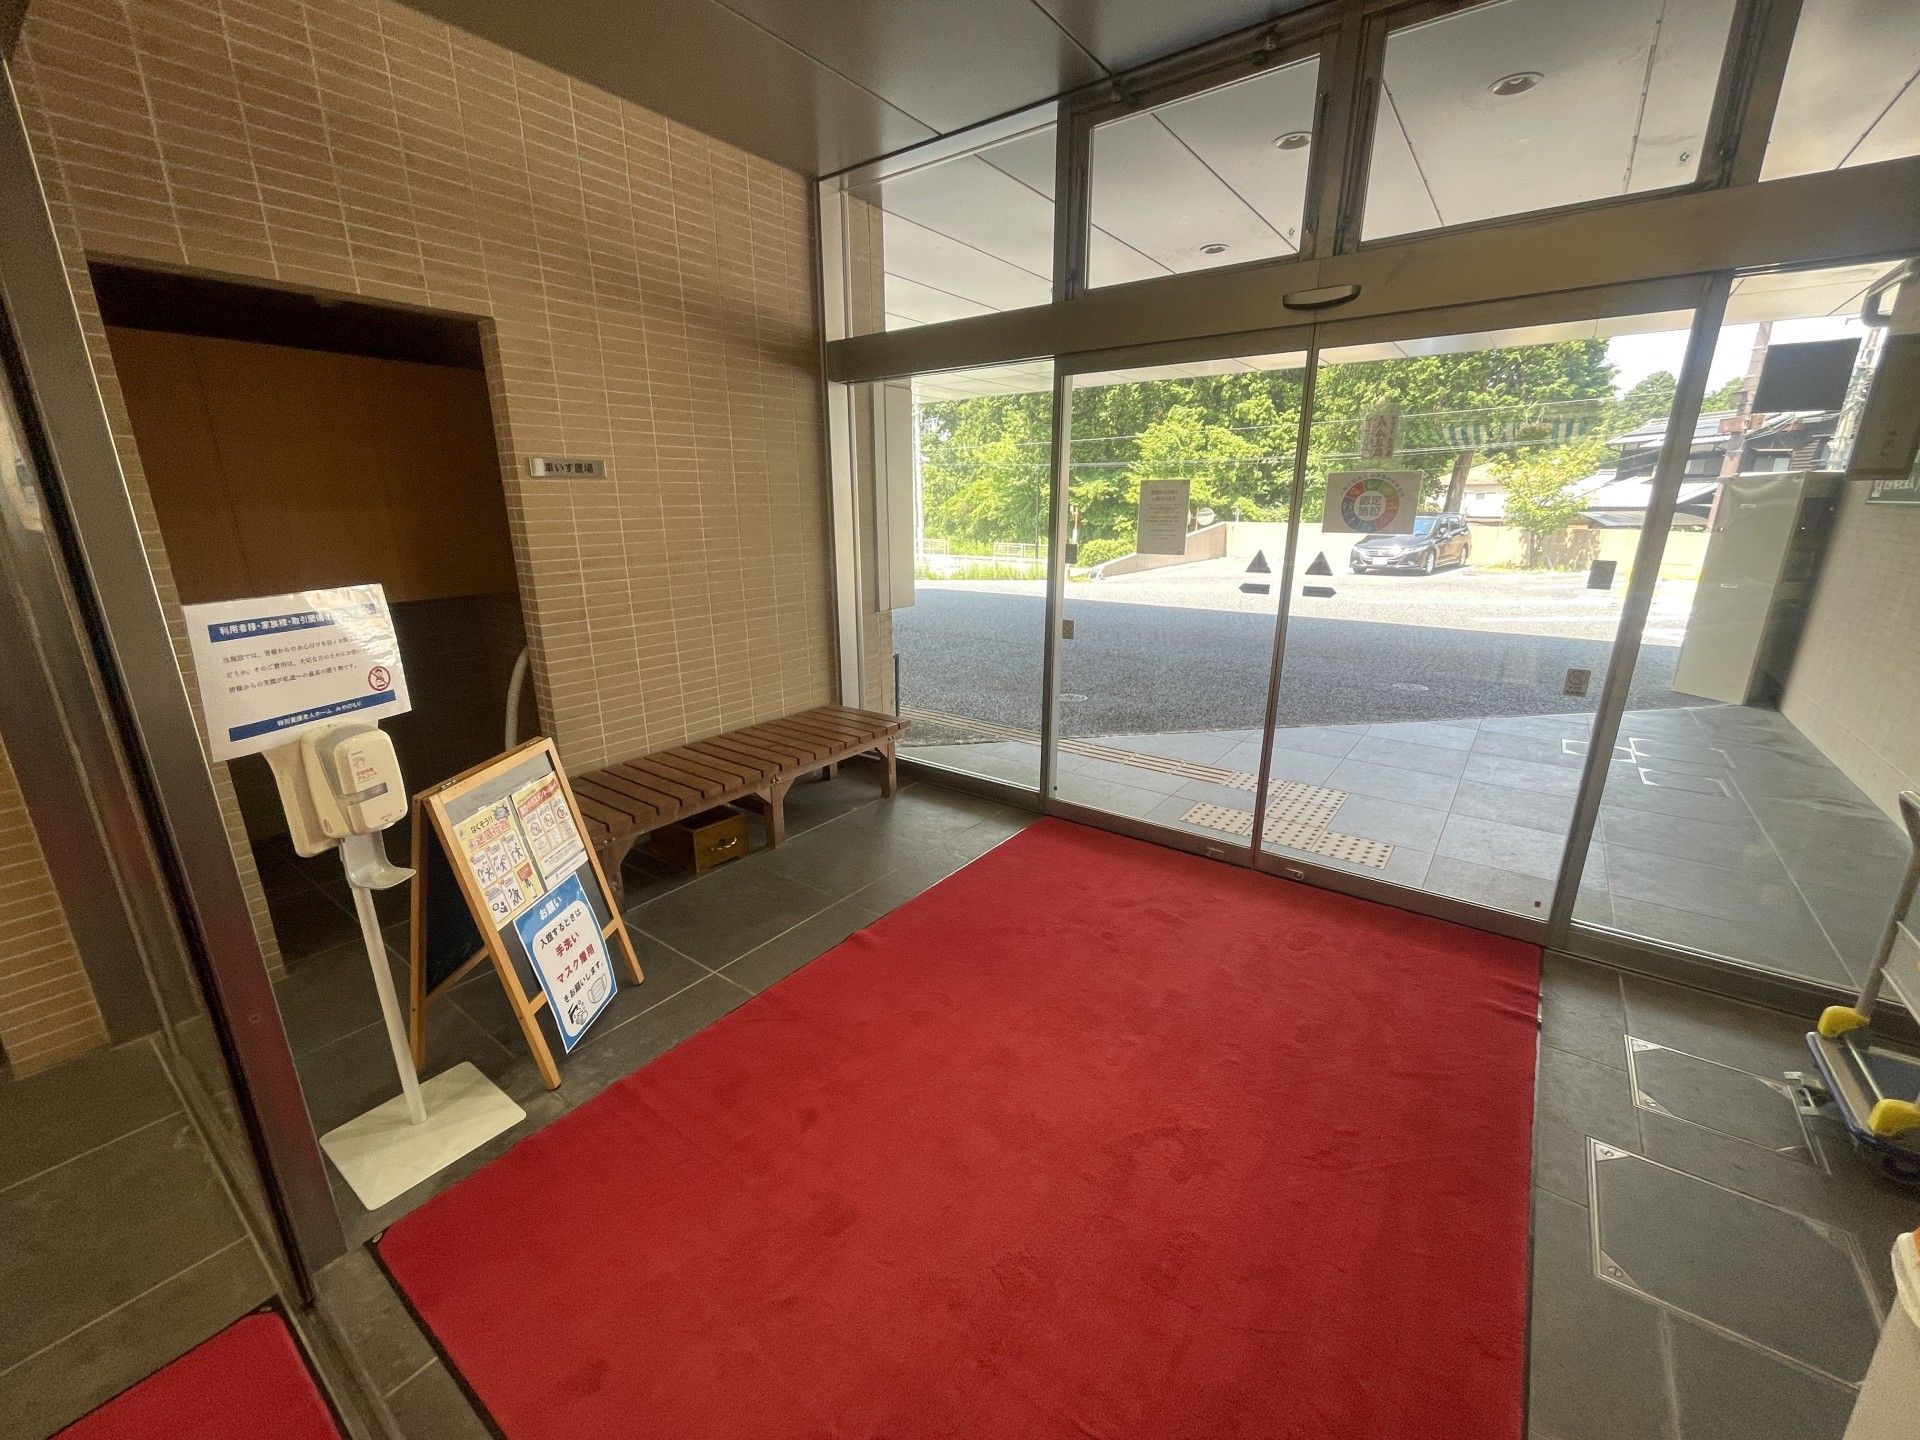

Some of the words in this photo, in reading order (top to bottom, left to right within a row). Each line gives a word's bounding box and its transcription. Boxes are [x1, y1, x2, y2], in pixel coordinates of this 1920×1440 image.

[538, 896, 562, 921] お願い
[554, 931, 580, 958] 手洗い
[556, 943, 595, 983] マスク着用
[563, 960, 604, 1003] をお願いします。
